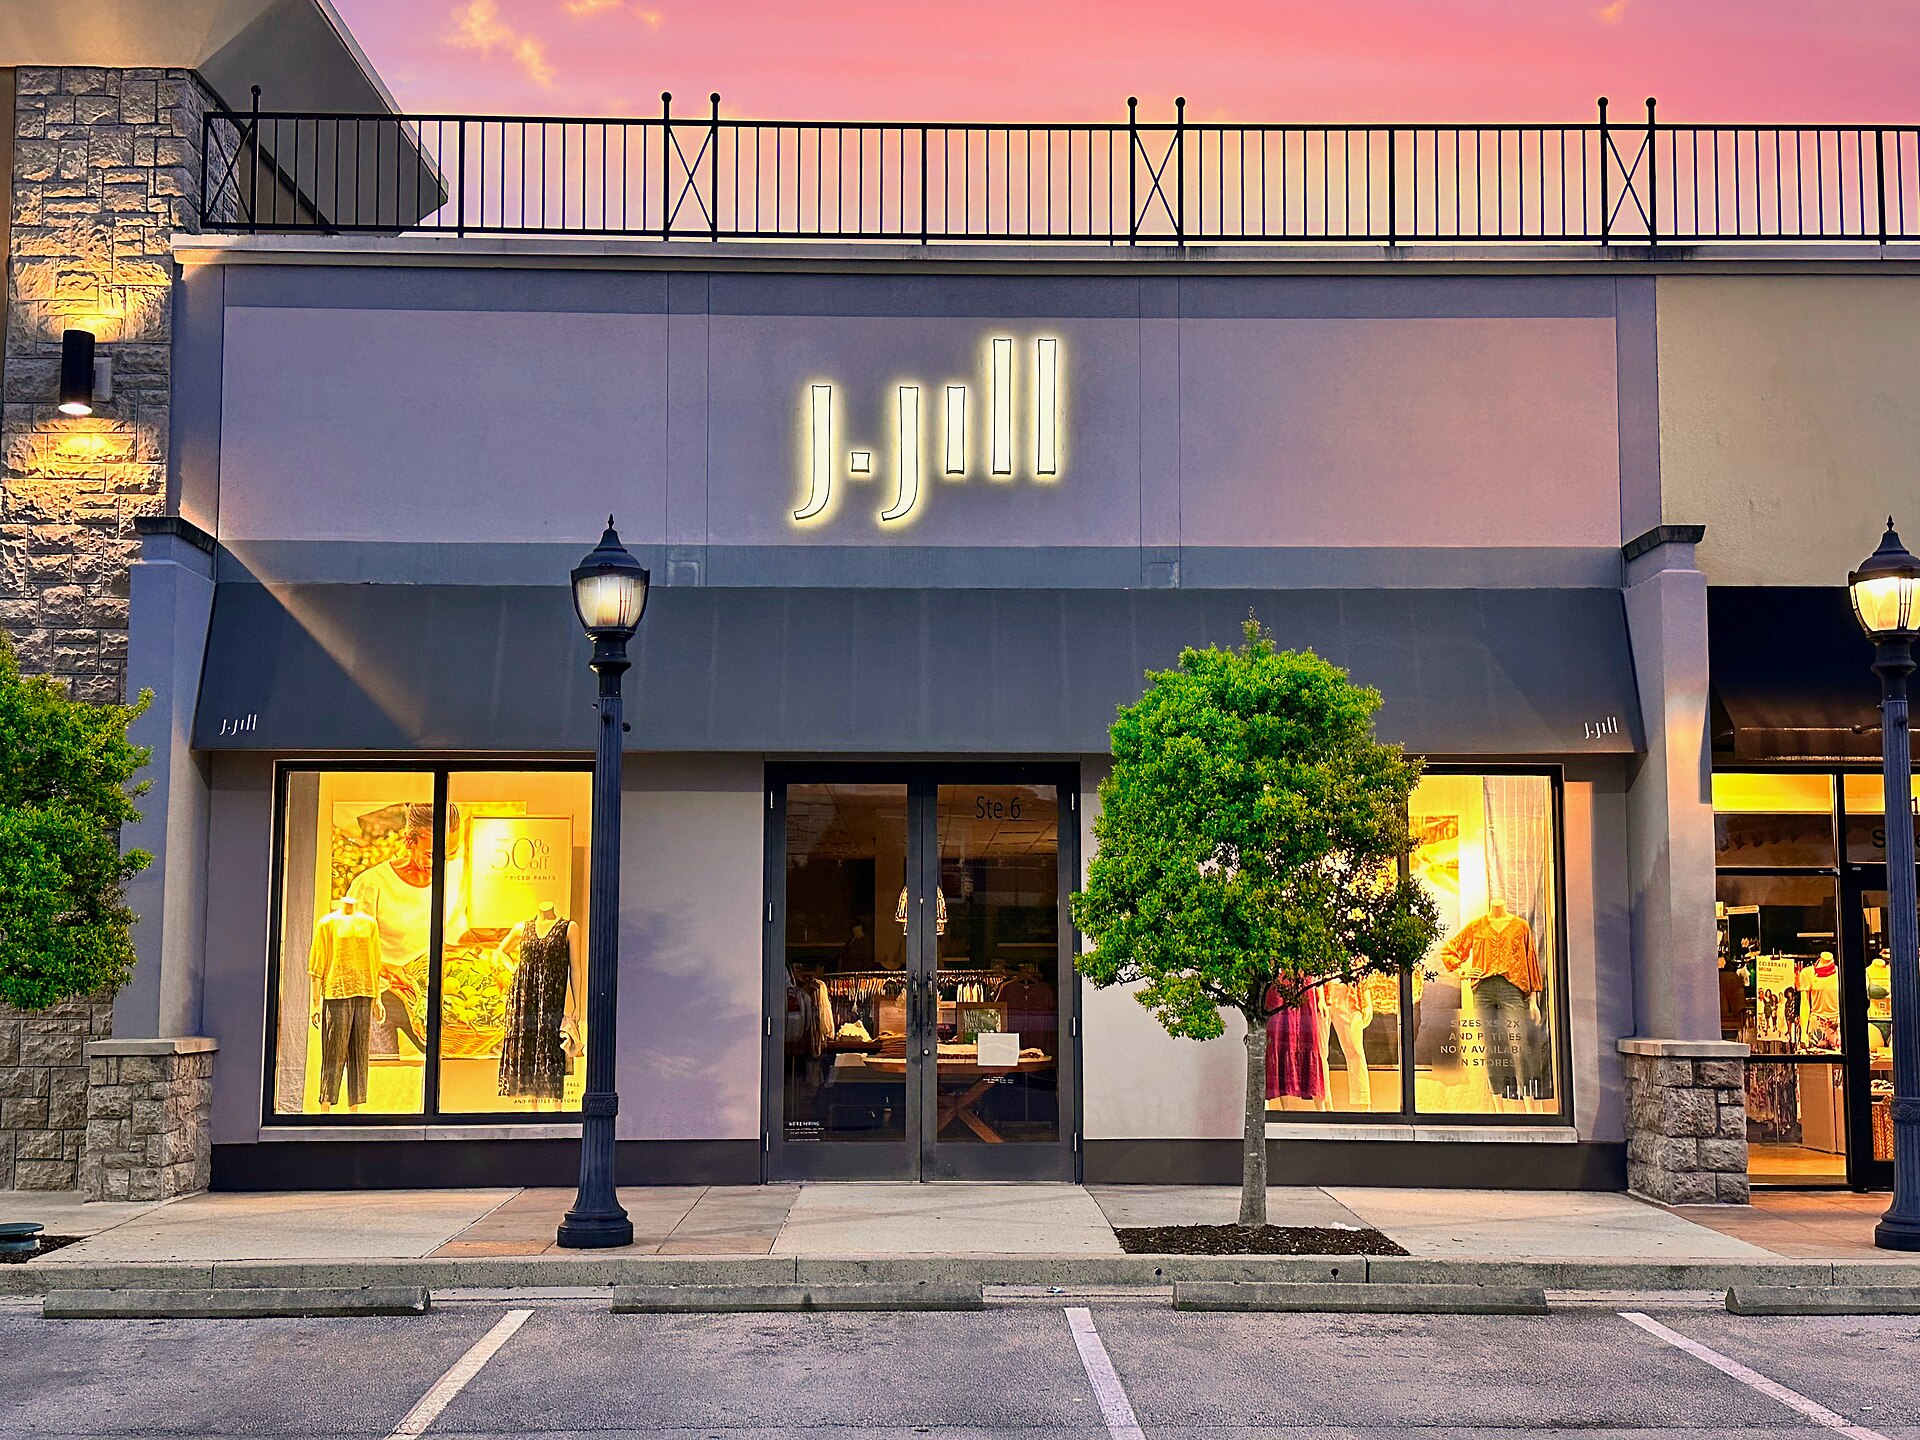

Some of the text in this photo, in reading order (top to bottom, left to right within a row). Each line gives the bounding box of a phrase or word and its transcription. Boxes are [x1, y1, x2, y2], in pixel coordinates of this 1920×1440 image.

[975, 795, 1021, 819] Ste 6
[529, 855, 551, 870] off
[1450, 1019, 1482, 1028] SIZES
[1448, 1032, 1522, 1041] AND PTIES
[1440, 1045, 1467, 1054] NOW
[1472, 1058, 1514, 1067] STORES
